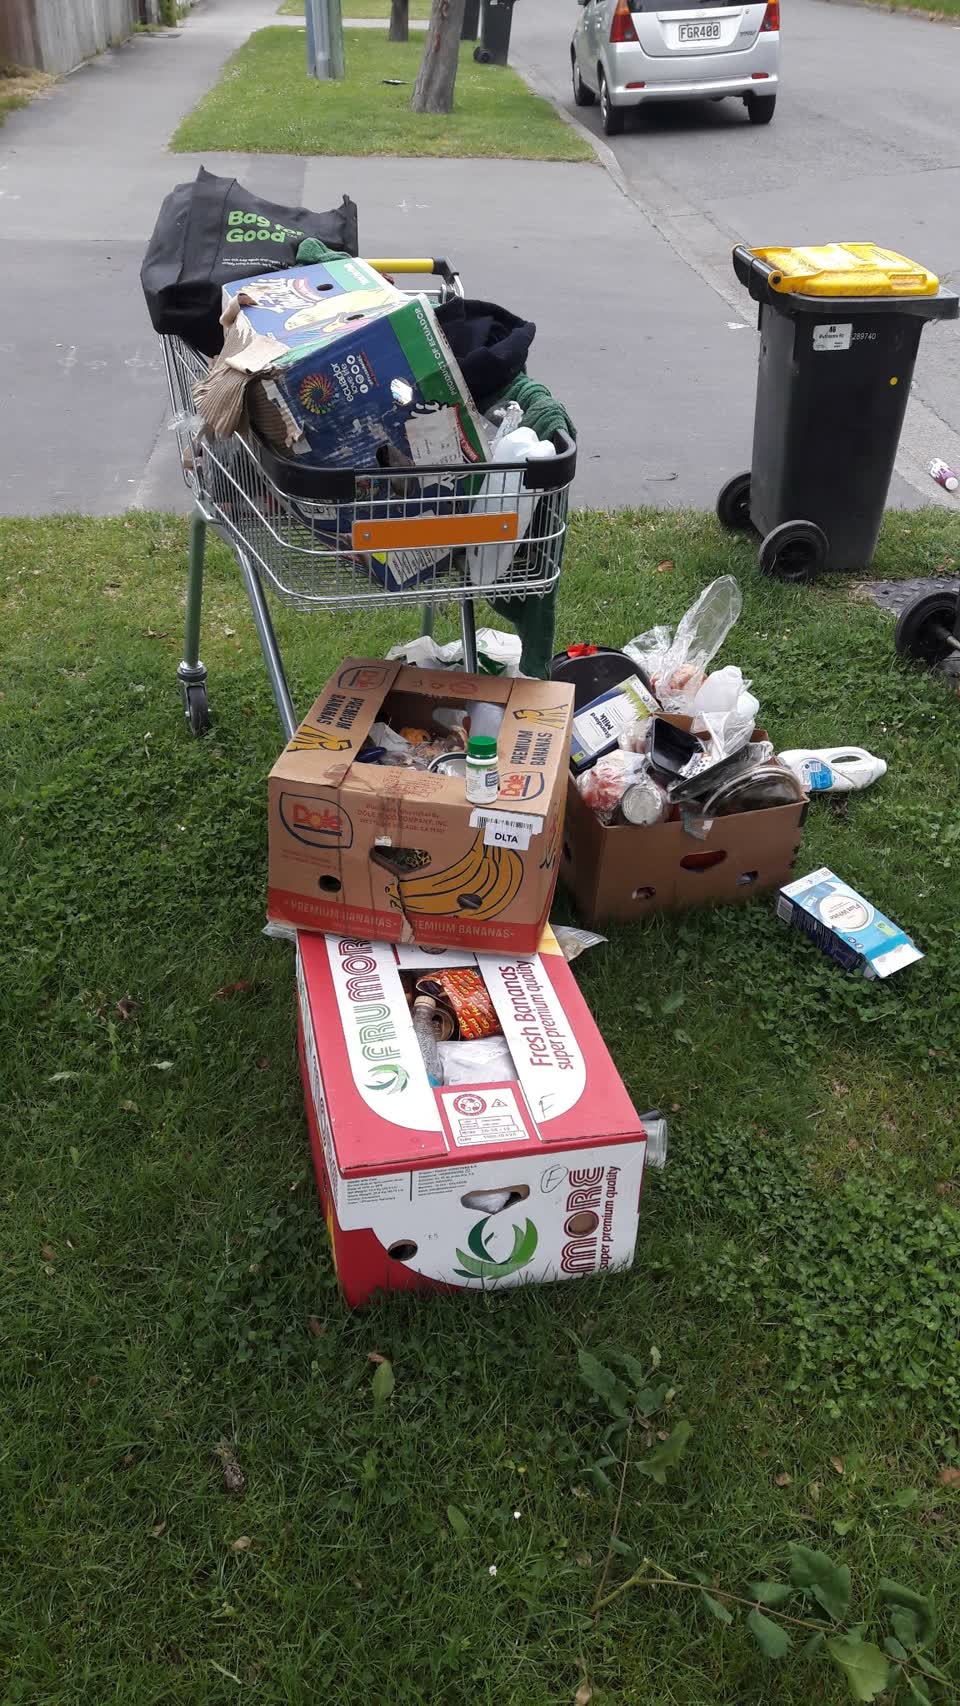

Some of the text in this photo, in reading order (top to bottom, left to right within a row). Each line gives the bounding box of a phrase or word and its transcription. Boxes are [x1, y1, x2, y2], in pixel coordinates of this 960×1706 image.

[680, 25, 719, 39] FGR400
[228, 210, 270, 227] Bag
[226, 228, 286, 242] Good
[414, 307, 437, 348] ECUADOR
[432, 347, 441, 359] OF
[330, 362, 354, 402] ecuador
[438, 361, 458, 396] PRODUCT
[316, 694, 346, 725] BANANAS
[336, 697, 365, 730] PREMIUM
[600, 713, 614, 730] Milk
[590, 712, 612, 739] Standard
[510, 730, 534, 765] PREMIUM
[530, 732, 552, 766] BANANAS
[500, 774, 526, 797] Dole
[294, 804, 343, 832] Dole
[494, 832, 518, 844] DLTA
[414, 920, 456, 935] REMIUM
[498, 966, 553, 1067] Fresh Bananas
[516, 960, 574, 1070] super premium quality
[546, 1166, 561, 1188] F
[561, 1166, 604, 1274] MORE
[601, 1166, 621, 1270] super premium quality
